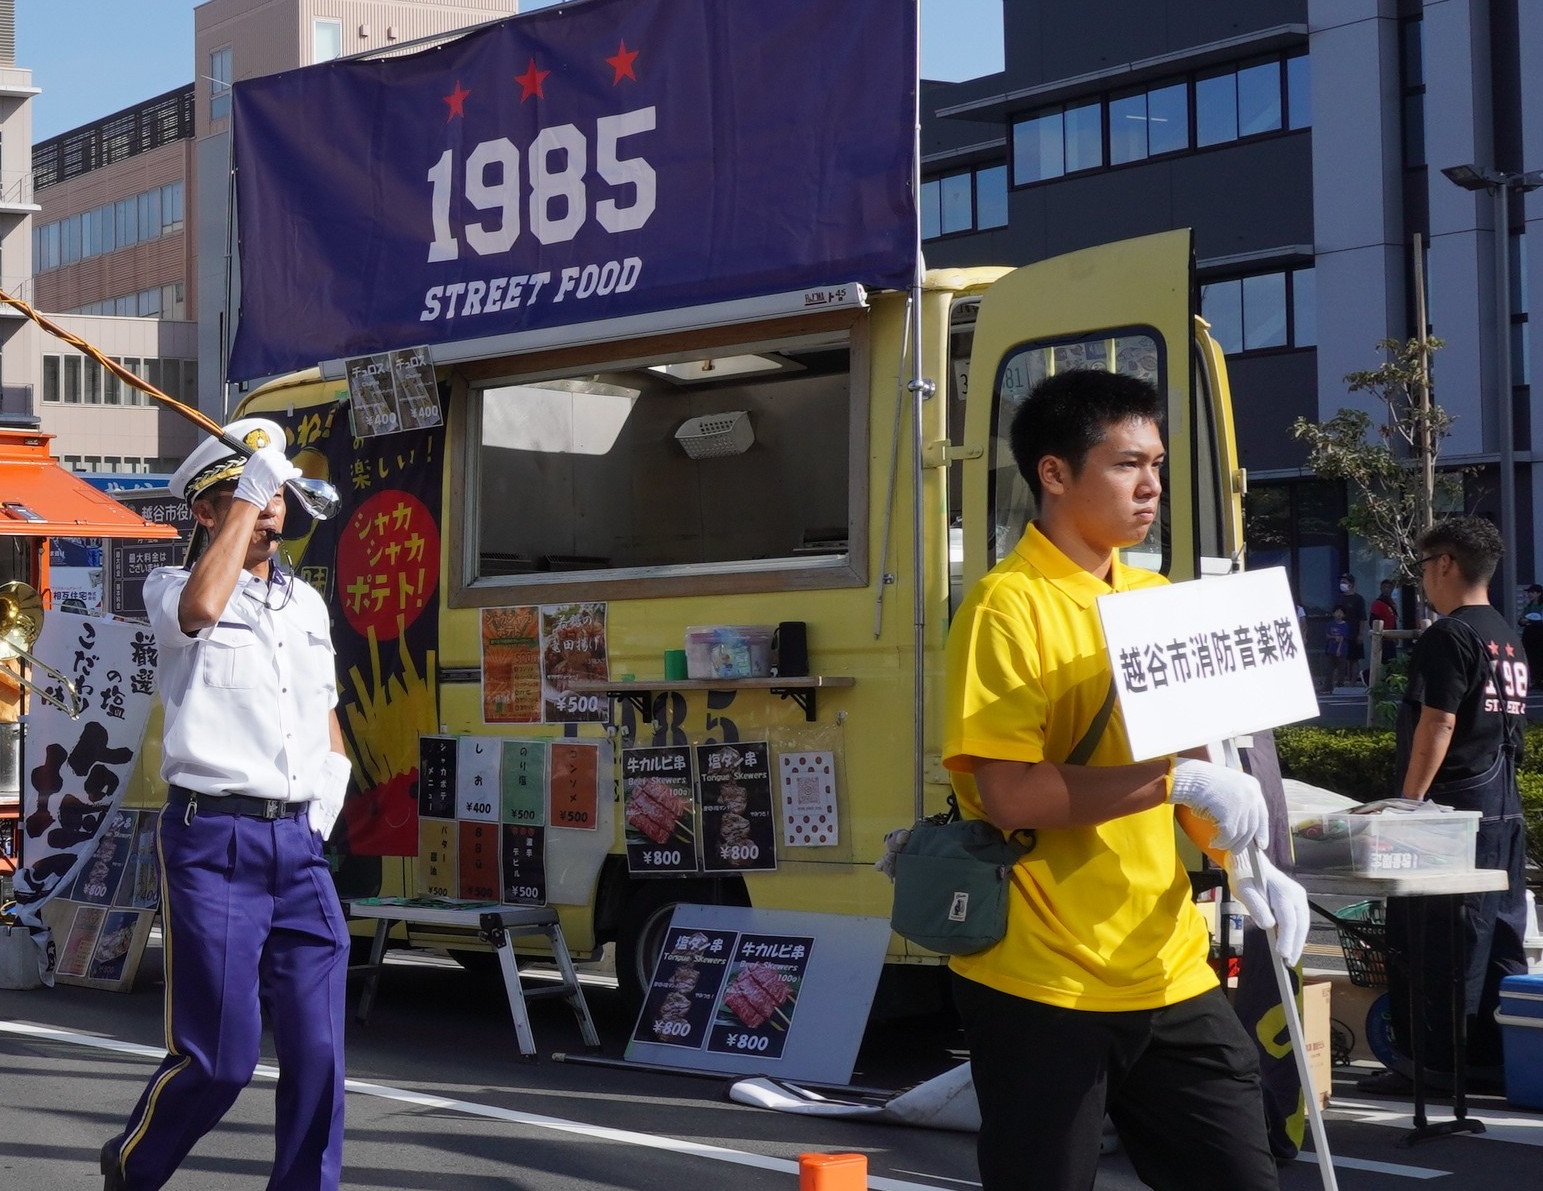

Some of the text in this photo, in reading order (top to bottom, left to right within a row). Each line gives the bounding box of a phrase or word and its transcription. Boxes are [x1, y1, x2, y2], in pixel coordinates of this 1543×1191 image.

[427, 105, 656, 263] 1985
[420, 256, 642, 321] STREET FOOD
[351, 361, 386, 376] チュロス
[396, 355, 427, 370] チュロス
[366, 412, 397, 426] ¥400
[411, 405, 438, 418] ¥400
[355, 502, 412, 540] シャカ
[367, 533, 425, 567] シャカ
[346, 568, 425, 615] ポテト!
[1120, 617, 1297, 694] 越谷市消防音楽隊
[556, 696, 598, 712] ¥500
[474, 744, 483, 786] しお
[627, 756, 687, 773] 牛カルビ串
[708, 751, 758, 770] 塩タン串
[569, 750, 577, 802] コンソメ
[650, 776, 687, 784] Skewers
[701, 772, 767, 783] Tongue Skewers
[466, 802, 491, 814] ¥400
[511, 808, 535, 820] ¥500
[559, 811, 588, 822] ¥500
[643, 850, 681, 865] ¥800
[720, 846, 759, 861] ¥800
[428, 886, 448, 896] ¥500
[511, 885, 538, 898] ¥500
[675, 935, 724, 952] 塩タン串
[741, 942, 805, 960] 牛カルビ串
[663, 952, 726, 965] Tongue Skewers
[761, 962, 799, 972] Skewers
[653, 1020, 691, 1037] ¥800
[726, 1033, 769, 1051] ¥800
